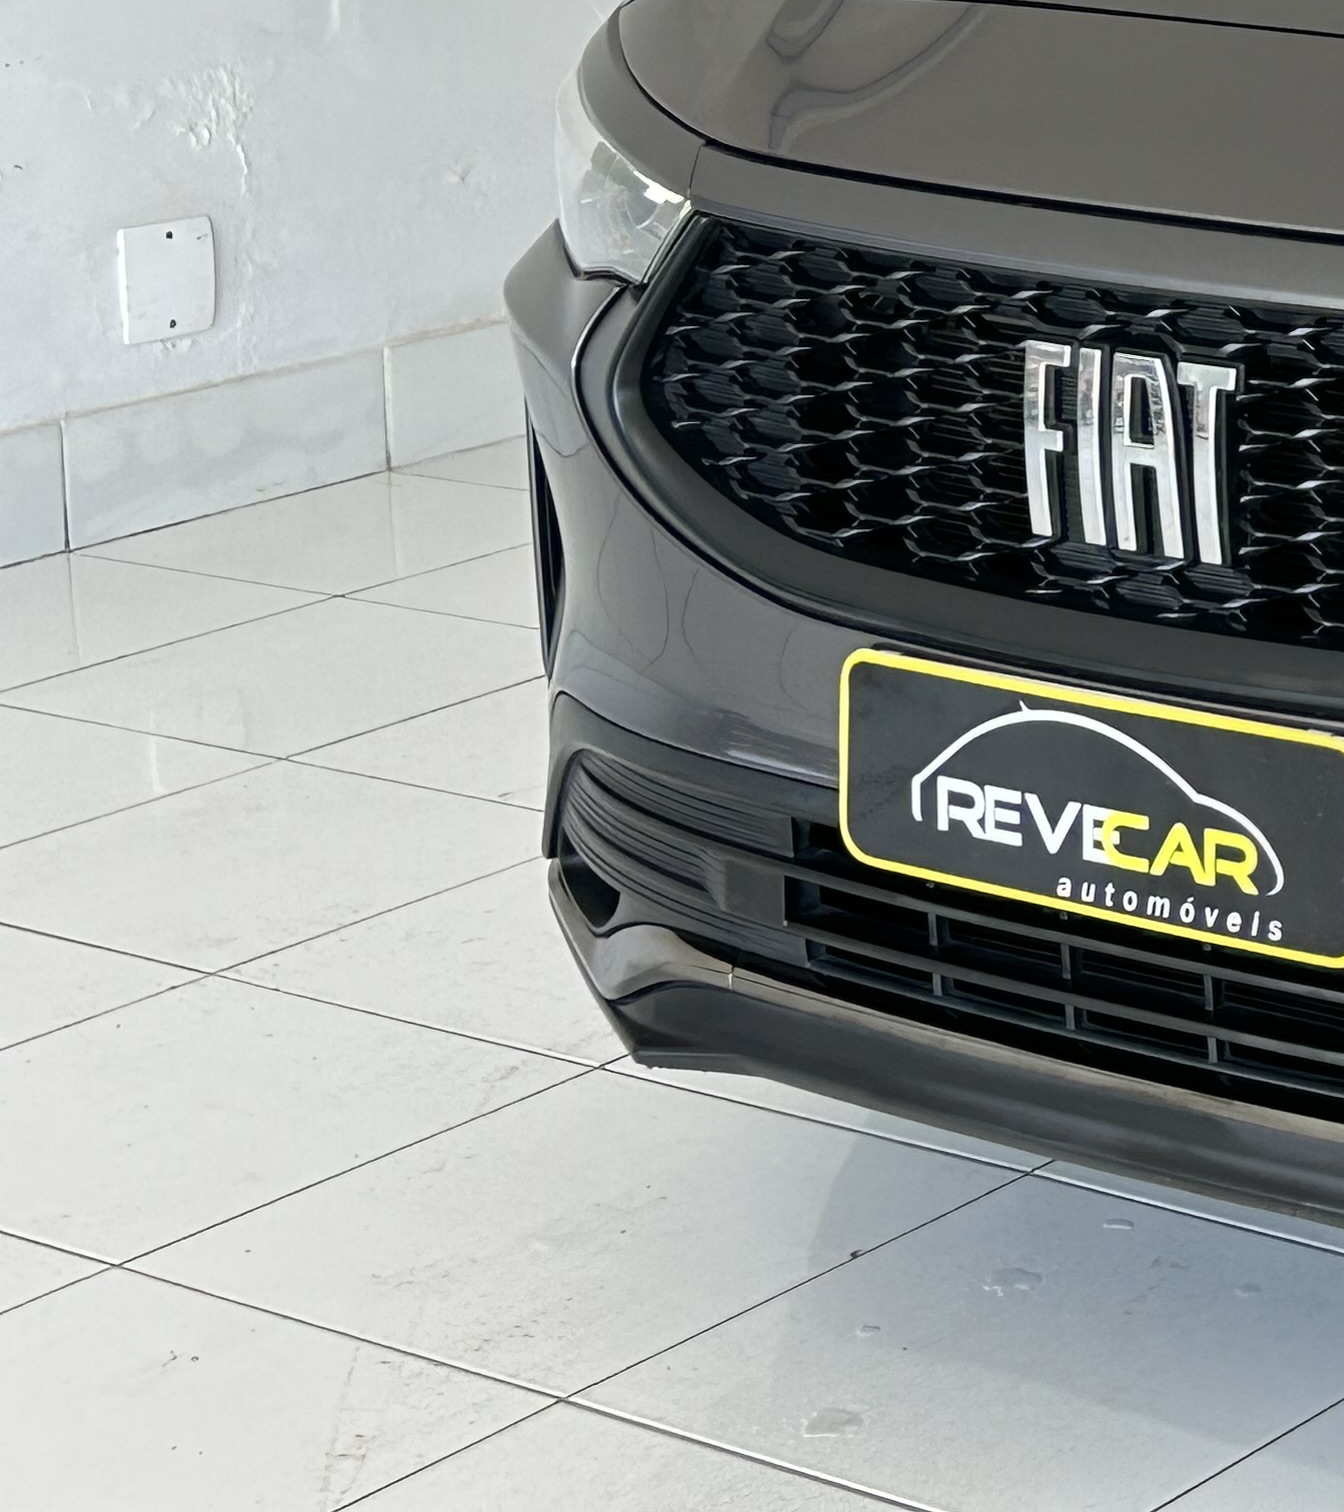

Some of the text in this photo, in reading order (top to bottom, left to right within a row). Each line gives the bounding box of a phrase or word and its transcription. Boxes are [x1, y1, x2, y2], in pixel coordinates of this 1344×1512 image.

[1024, 339, 1237, 566] FIAT
[937, 775, 1259, 895] REVECAR
[1057, 875, 1284, 943] automóveis
